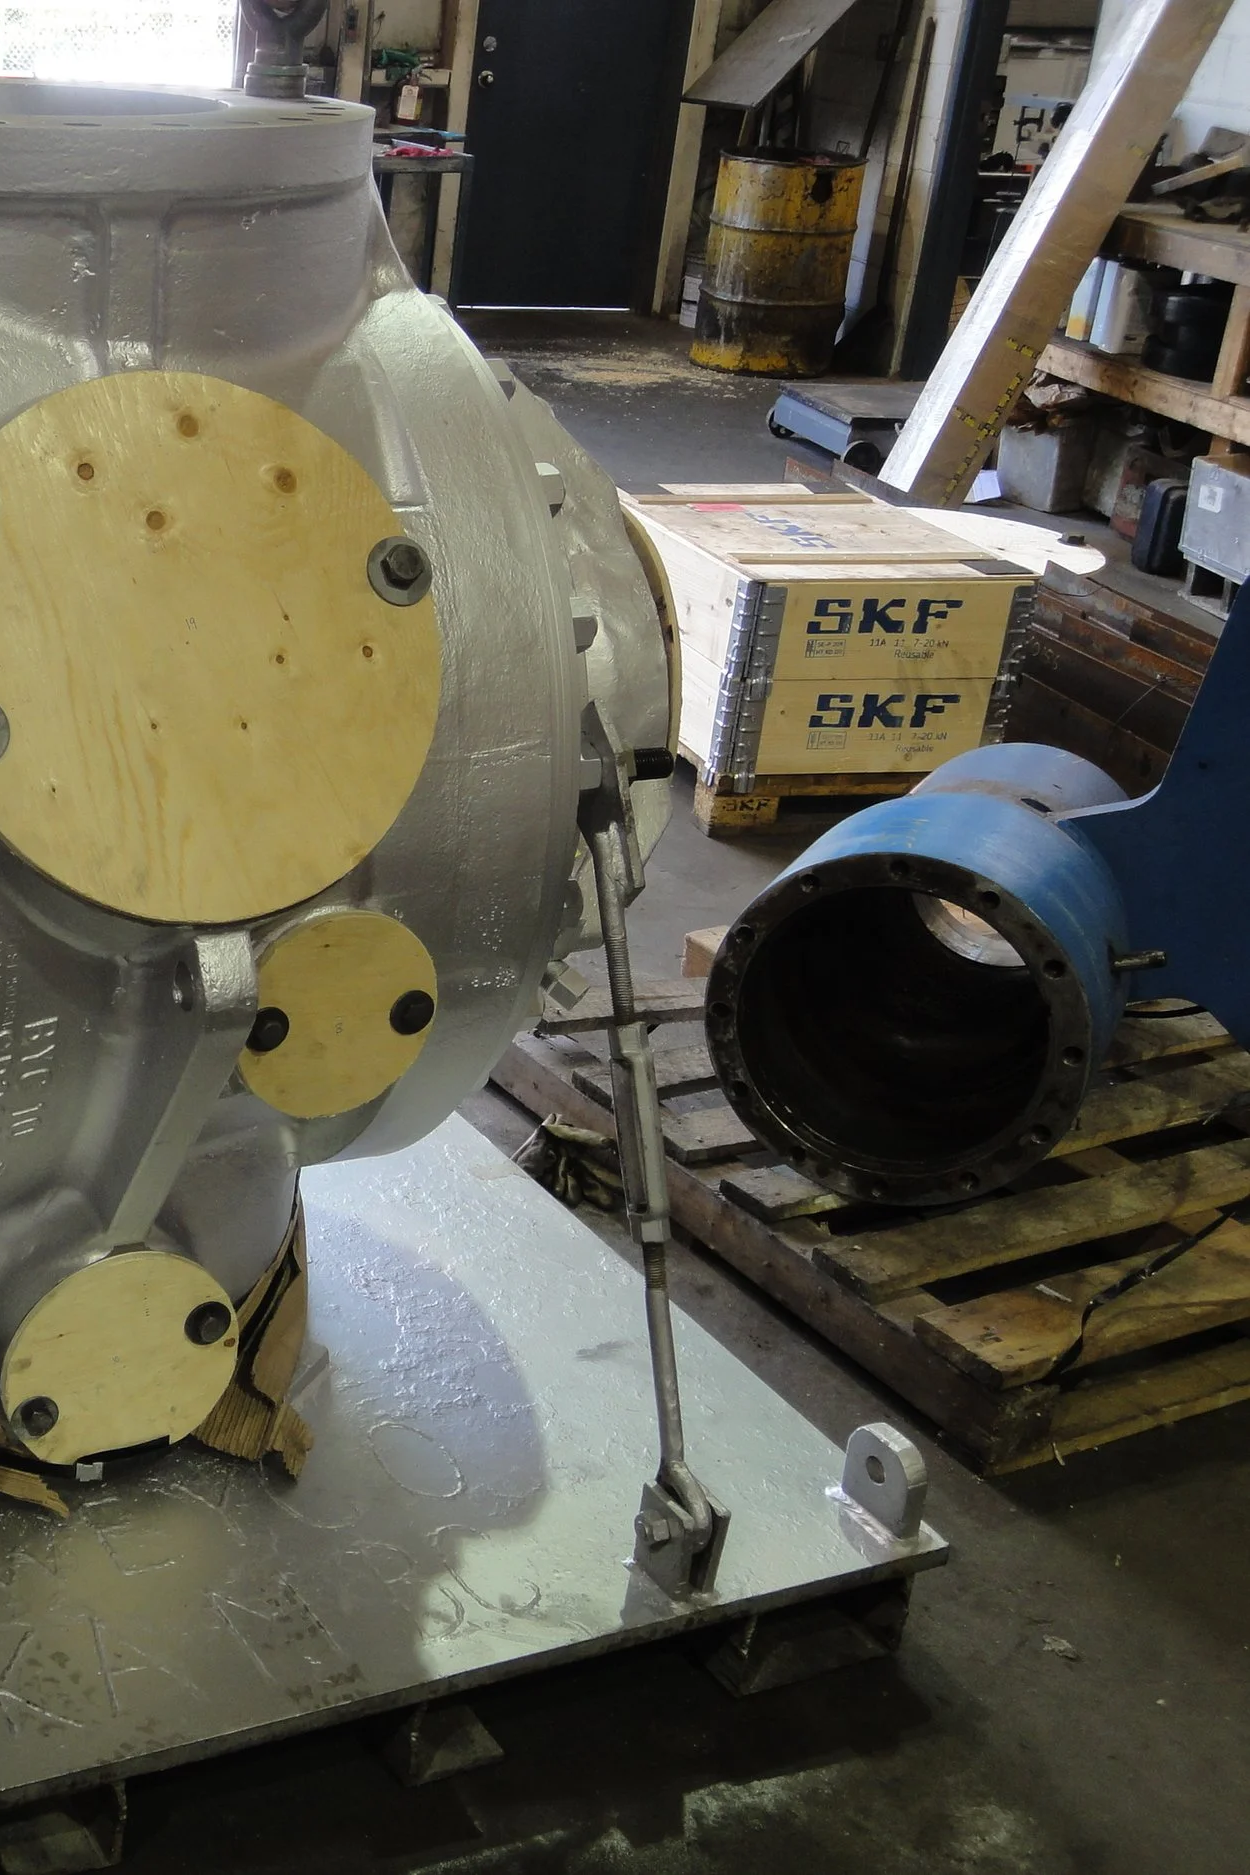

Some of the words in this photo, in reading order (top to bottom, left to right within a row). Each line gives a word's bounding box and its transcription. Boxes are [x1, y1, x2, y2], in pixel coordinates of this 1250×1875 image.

[742, 511, 837, 550] SKF
[806, 598, 964, 634] SKF
[893, 649, 935, 660] Reusable
[808, 694, 961, 728] SKF
